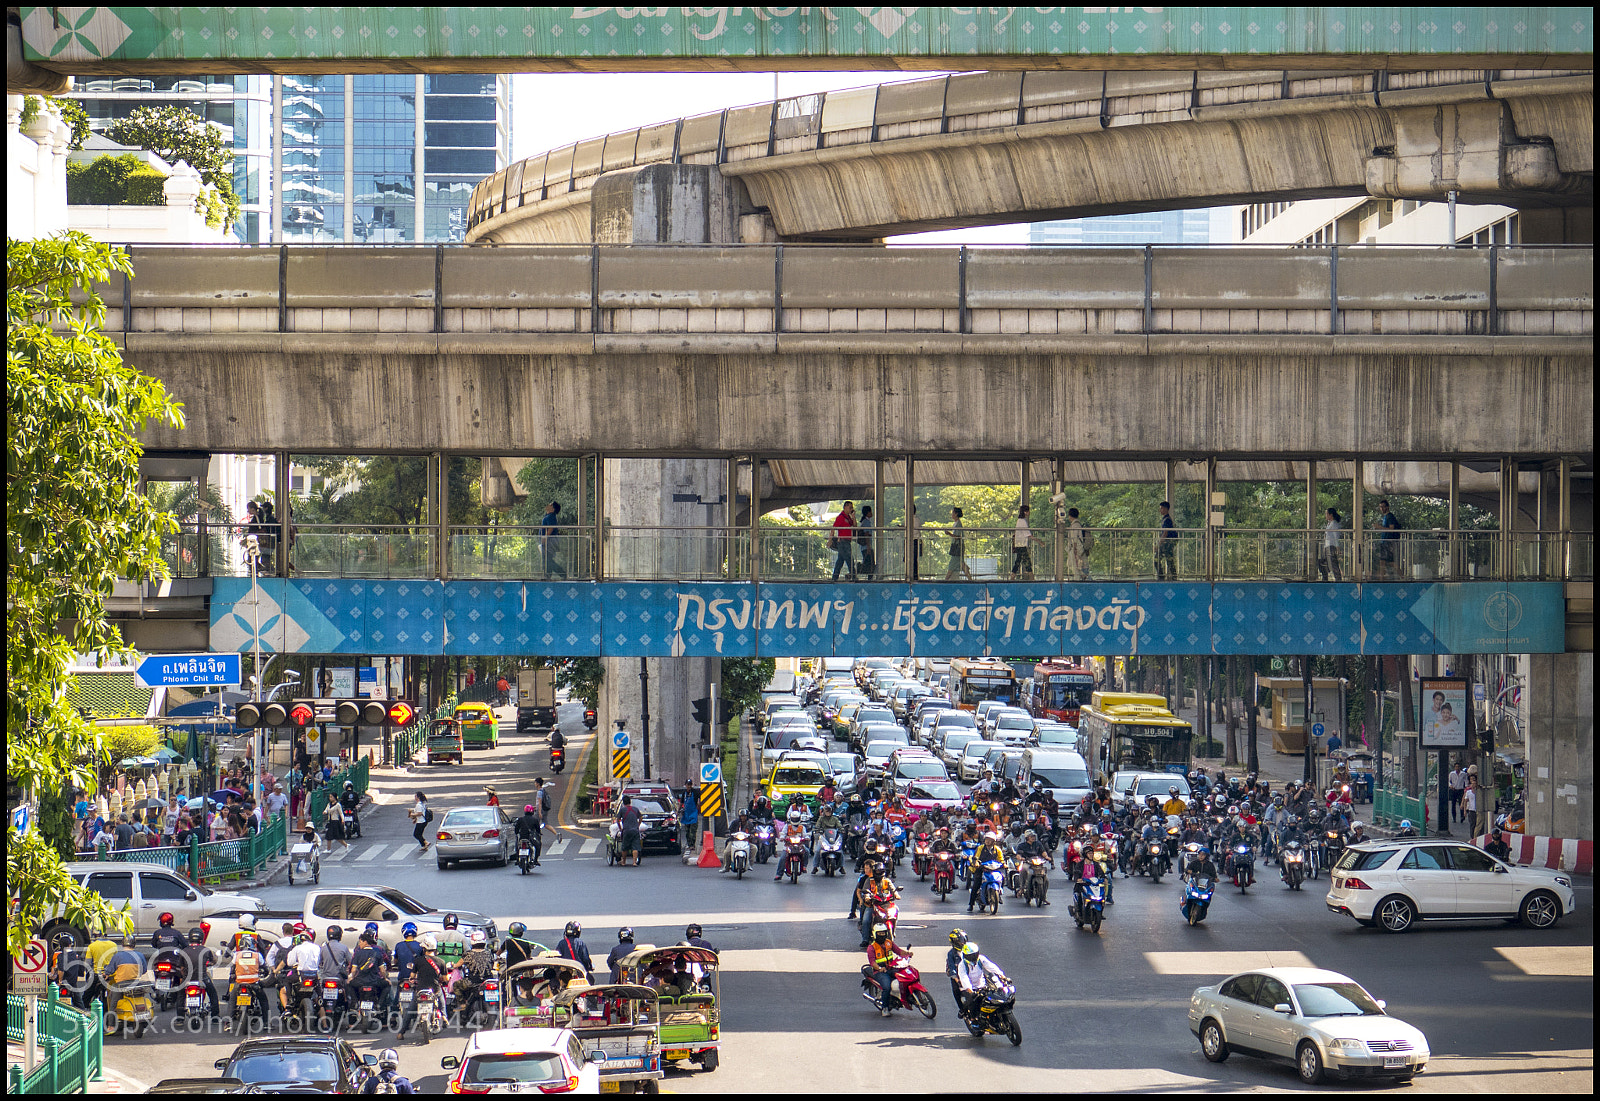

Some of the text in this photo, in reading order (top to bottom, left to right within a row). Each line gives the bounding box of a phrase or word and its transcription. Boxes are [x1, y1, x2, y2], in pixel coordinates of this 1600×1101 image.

[162, 658, 226, 674] ถ.เพลินจิต
[214, 674, 226, 682] Rd.
